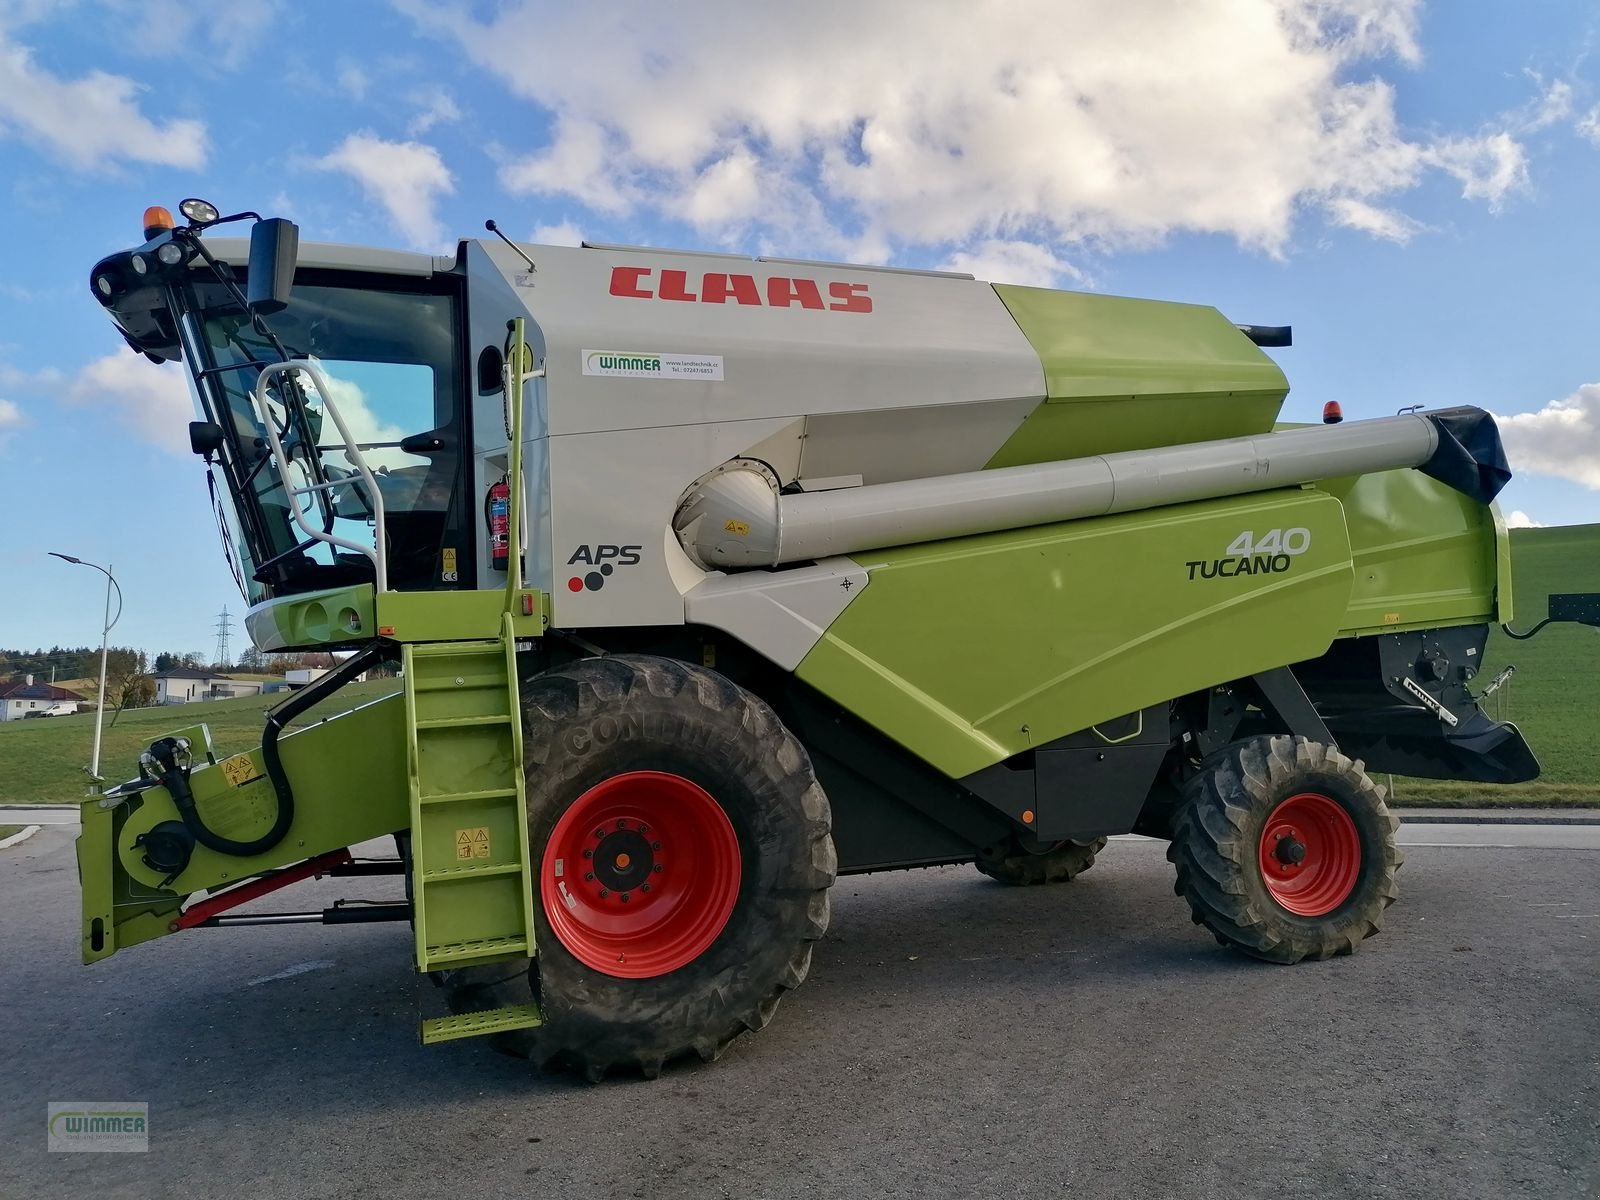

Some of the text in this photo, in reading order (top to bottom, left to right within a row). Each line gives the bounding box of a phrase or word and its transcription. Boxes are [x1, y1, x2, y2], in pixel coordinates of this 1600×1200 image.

[609, 267, 872, 313] CLAAS
[600, 357, 661, 371] WIMMER
[567, 544, 642, 565] APS
[1226, 527, 1311, 558] 440
[1186, 554, 1291, 580] TUCANO
